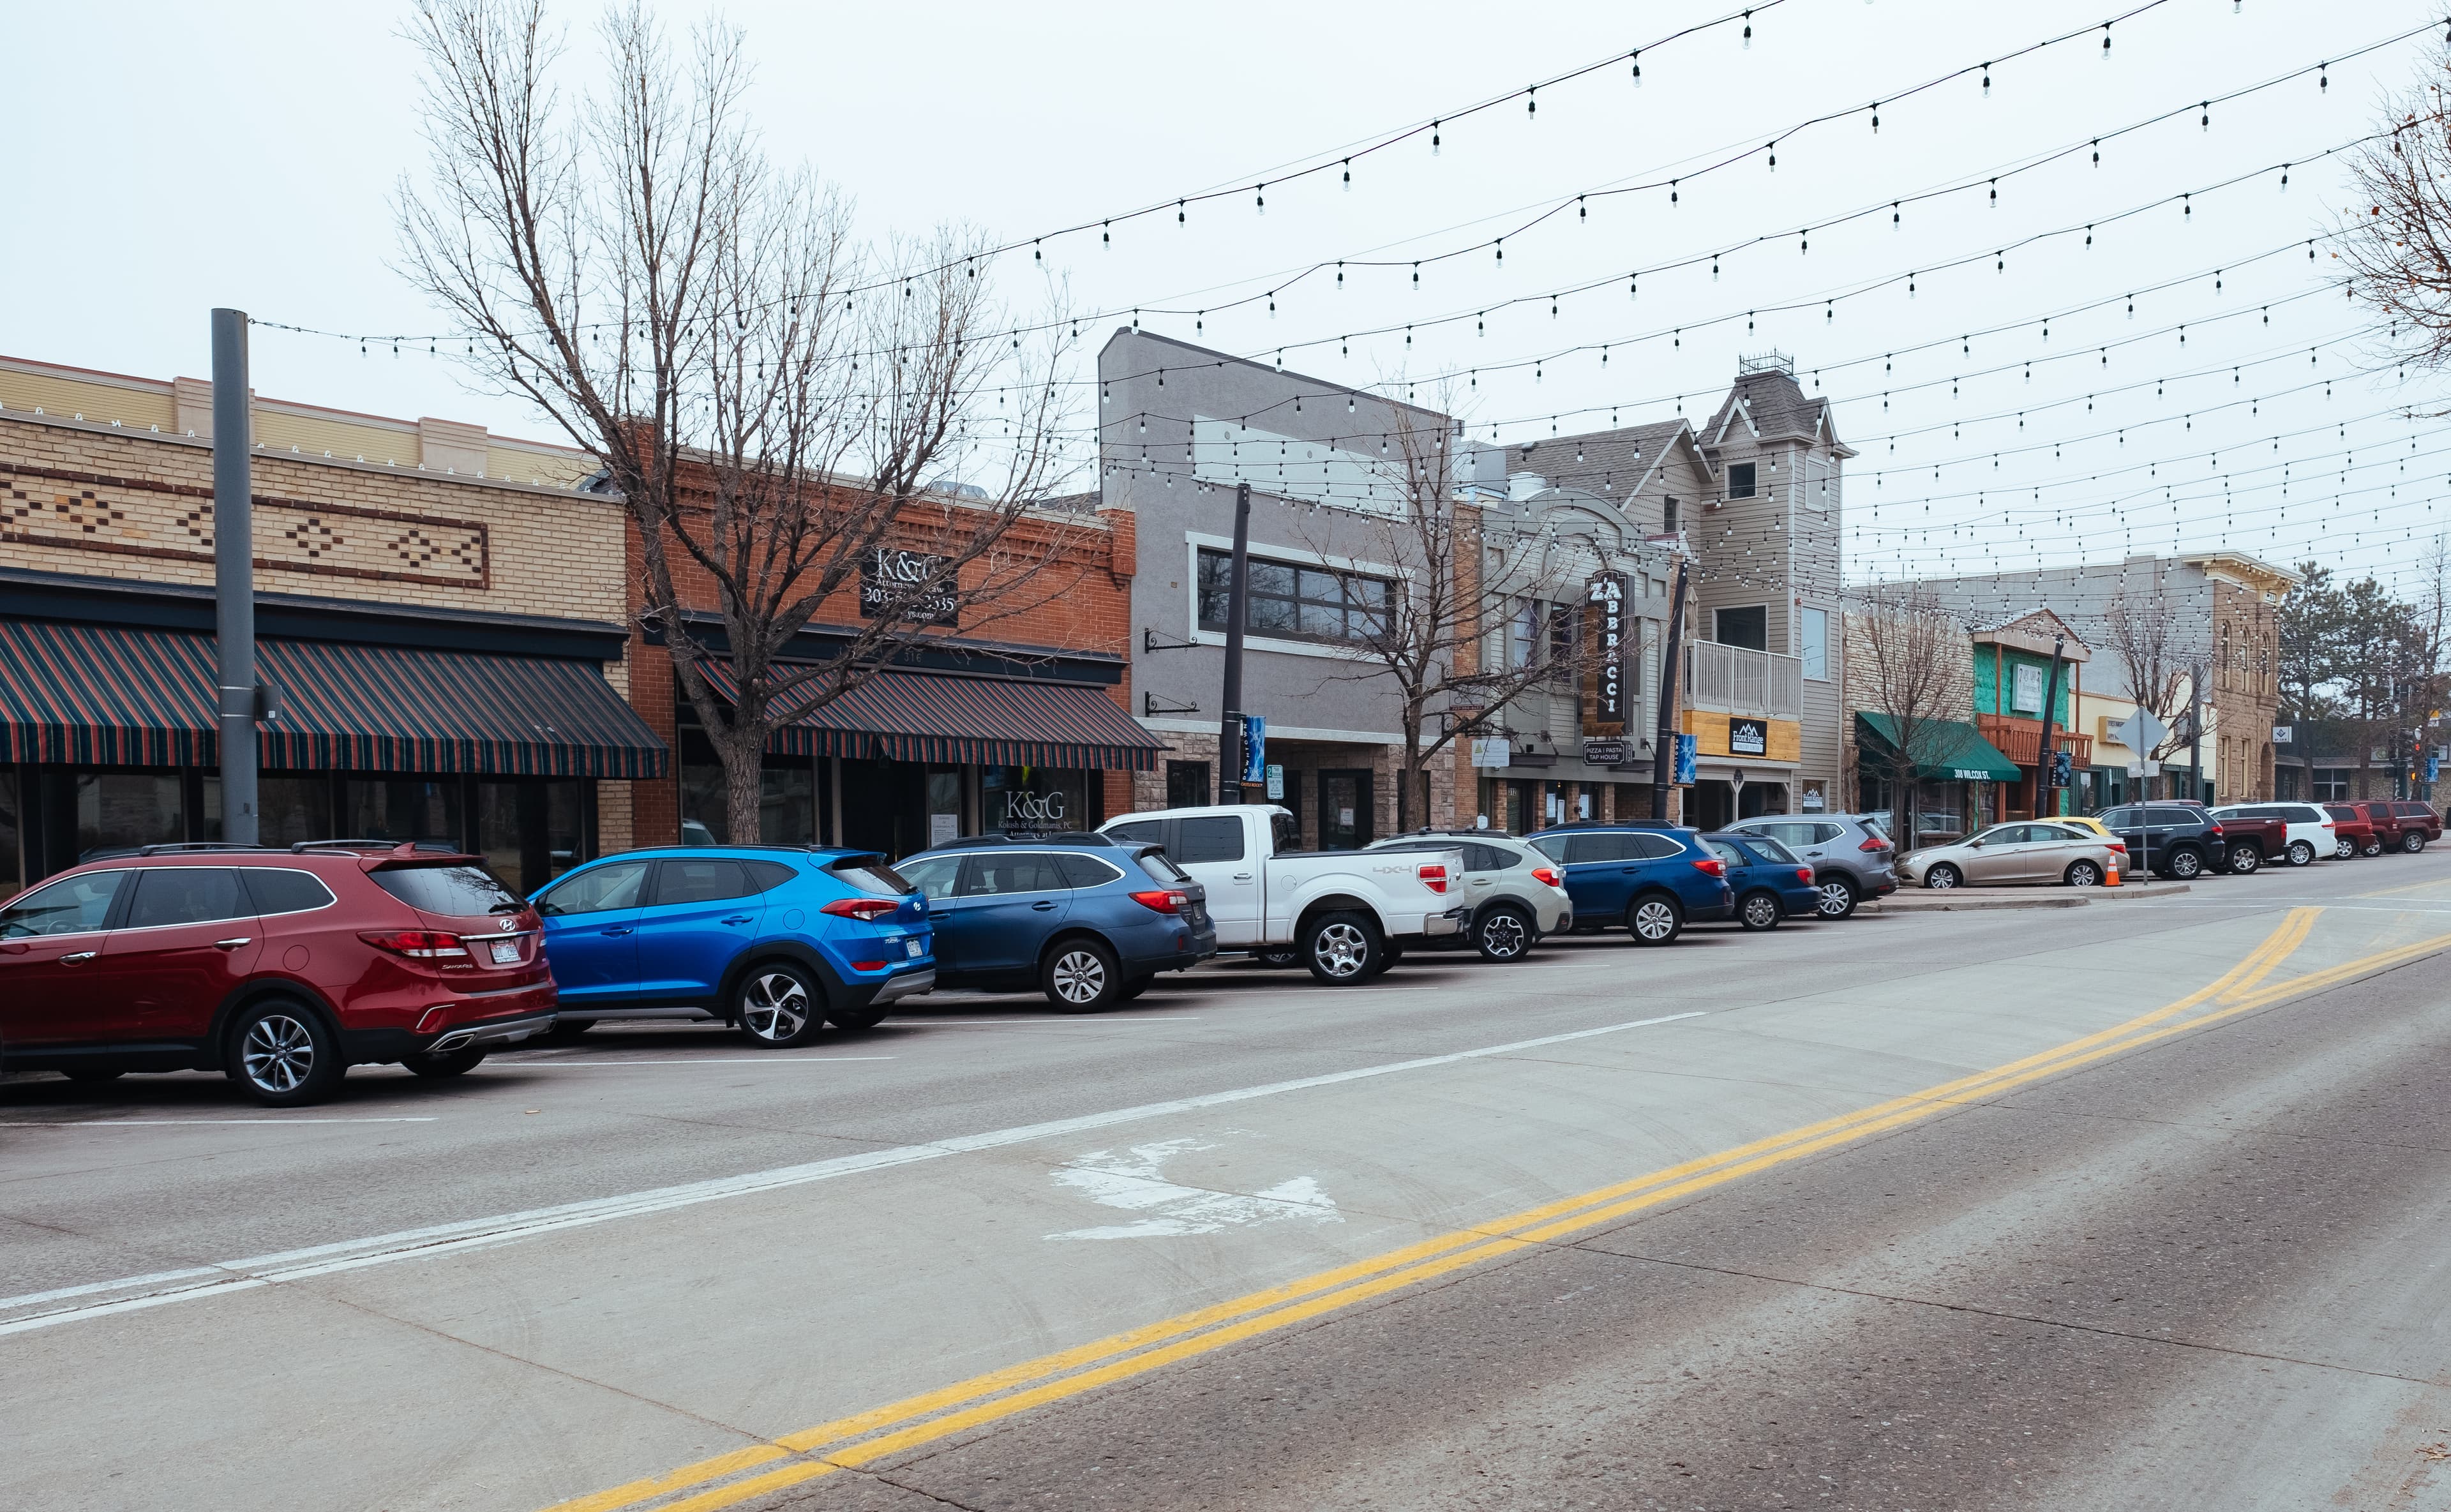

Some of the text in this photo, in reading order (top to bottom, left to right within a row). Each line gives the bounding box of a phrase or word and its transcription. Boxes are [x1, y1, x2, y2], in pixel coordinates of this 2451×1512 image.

[1733, 730, 1764, 745] Front Range
[1268, 767, 1272, 777] 2
[1954, 769, 1991, 779] 308 WILCOX ST.
[1005, 791, 1065, 820] K&G
[998, 820, 1019, 828] Kokish
[1028, 821, 1063, 830] Goldmanis,
[1063, 821, 1073, 830] PC
